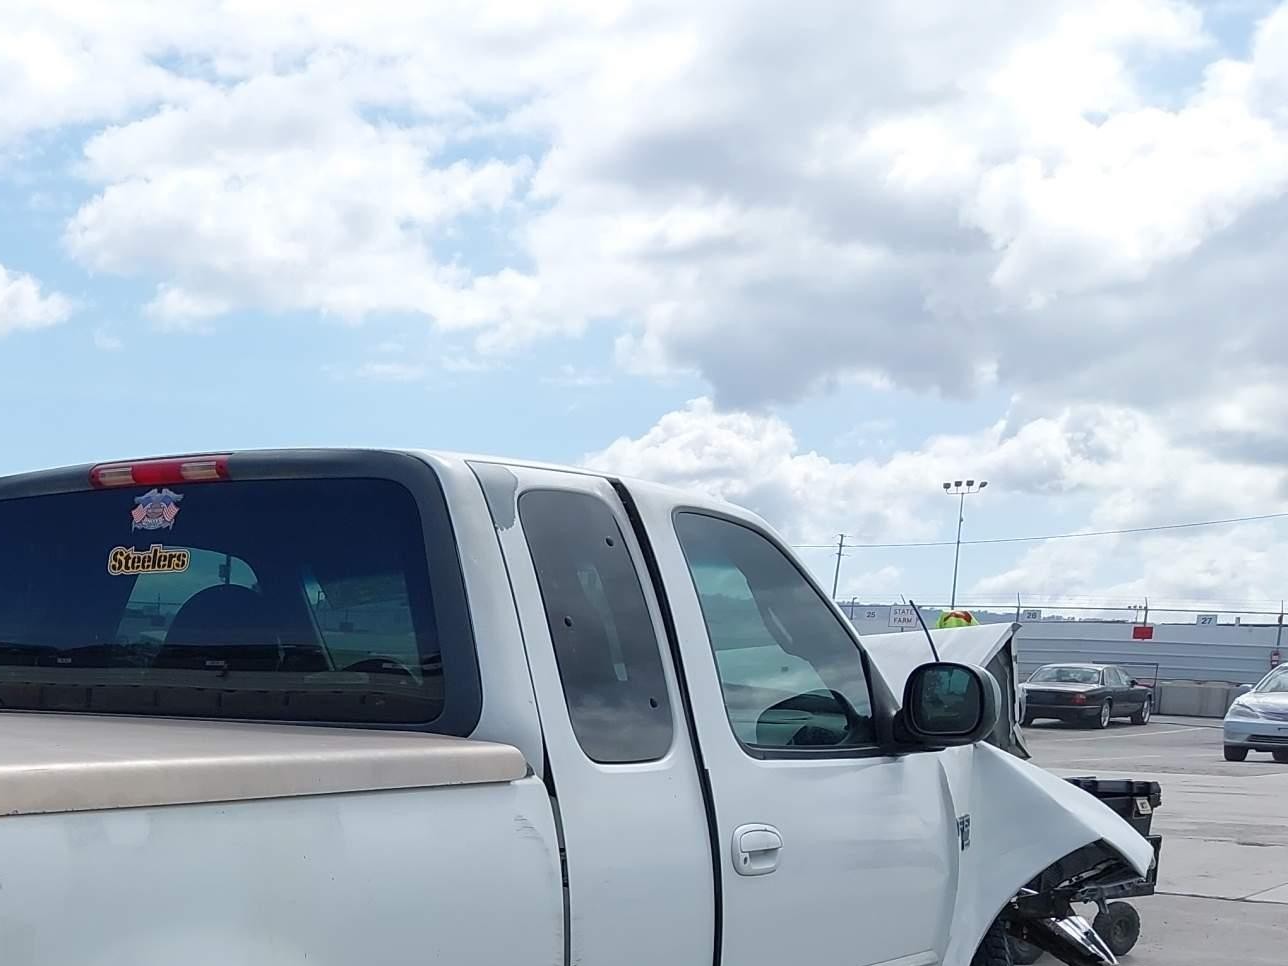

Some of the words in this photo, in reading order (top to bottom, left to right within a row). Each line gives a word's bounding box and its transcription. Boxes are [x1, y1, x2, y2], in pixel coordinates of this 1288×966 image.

[111, 547, 188, 572] Steelers
[893, 608, 914, 616] STATE
[1201, 617, 1213, 625] 27
